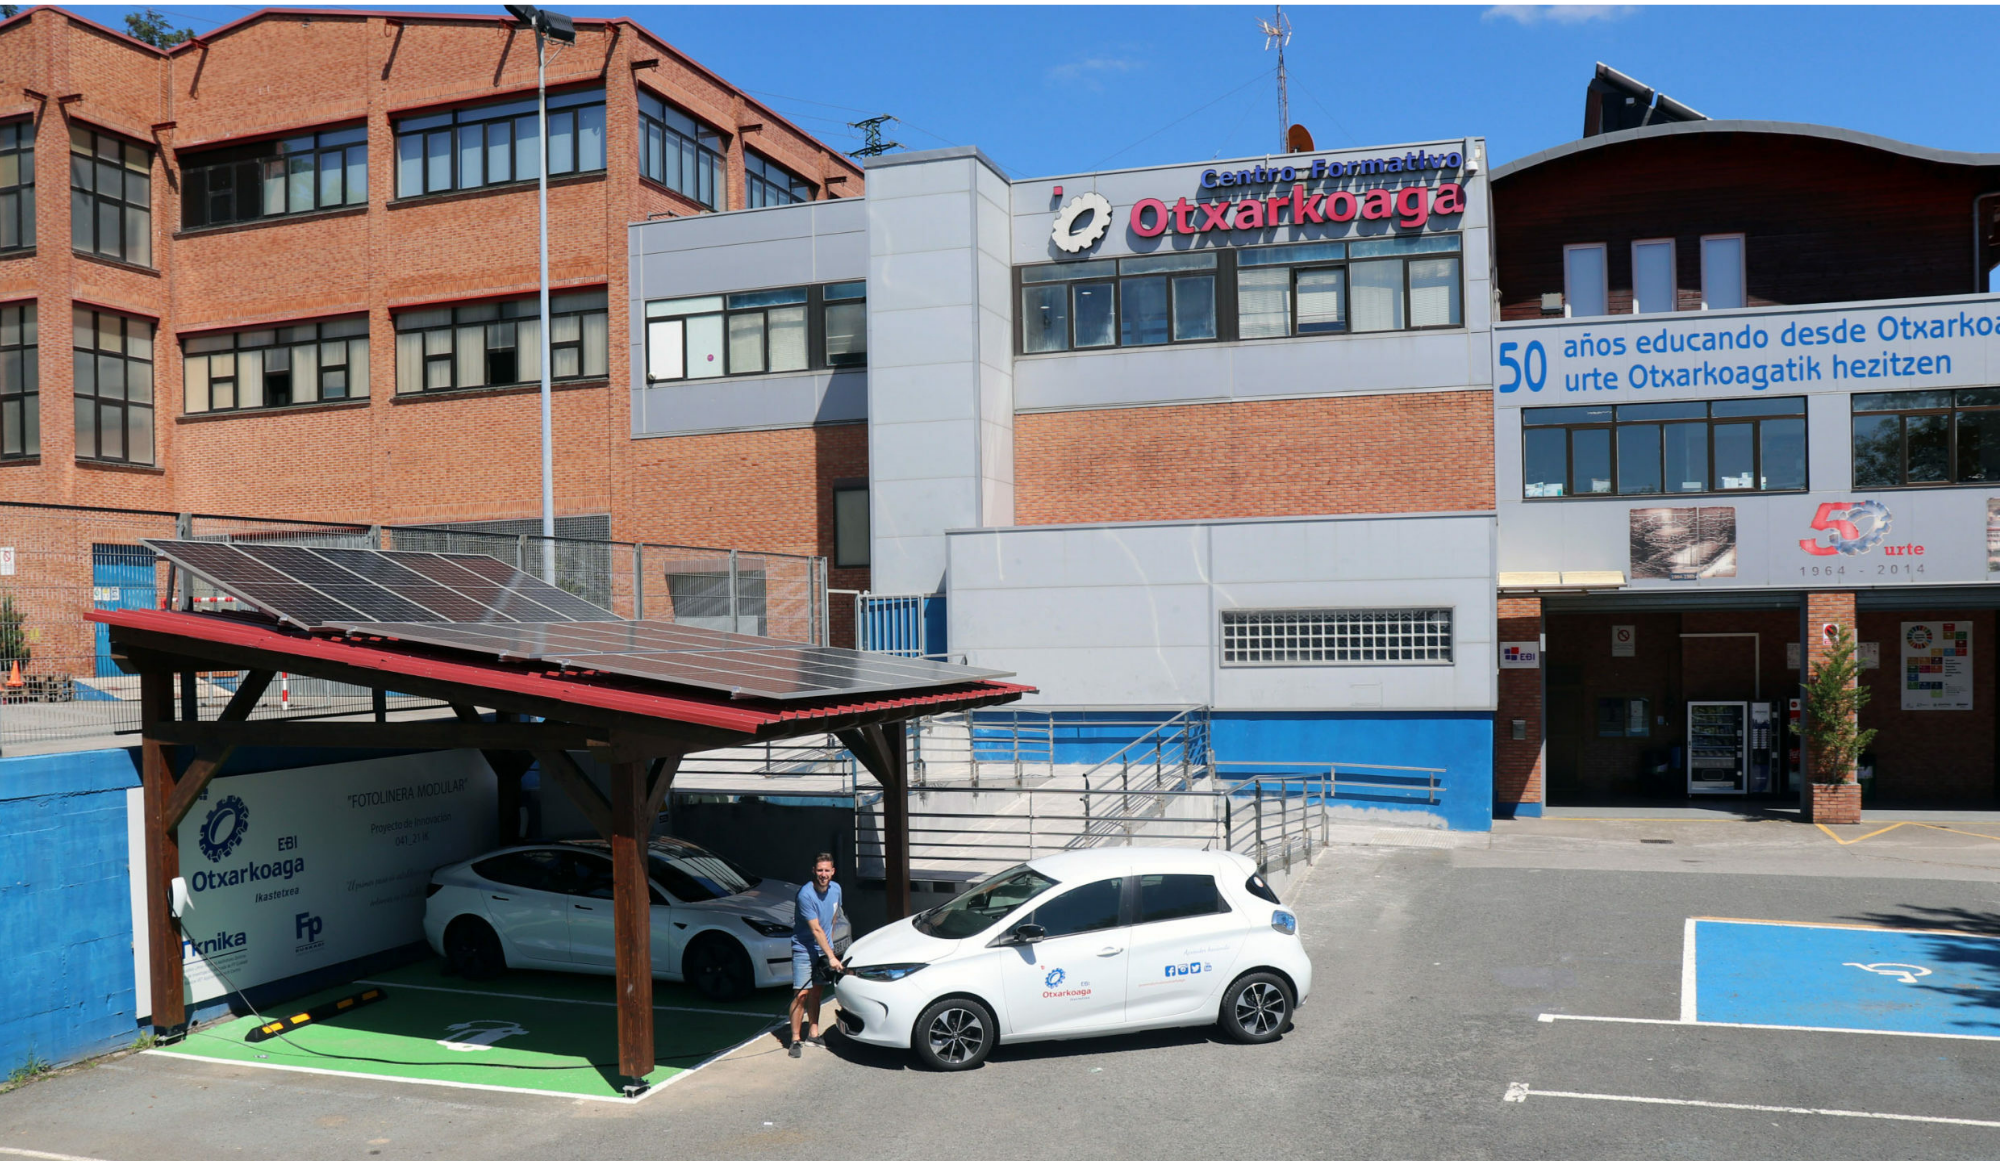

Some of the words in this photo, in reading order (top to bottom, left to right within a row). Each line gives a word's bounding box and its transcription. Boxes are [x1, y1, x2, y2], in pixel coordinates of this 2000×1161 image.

[1200, 164, 1296, 189] Centro
[1311, 150, 1463, 179] Formativo
[1130, 183, 1465, 238] Otxarkoaga
[1564, 332, 1626, 358] años
[1636, 325, 1769, 354] educando
[1780, 318, 1866, 347] desde
[1499, 340, 1547, 393] 50
[1565, 367, 1618, 391] urte
[1629, 356, 1821, 390] Otxarkoagatik
[1832, 351, 1951, 380] hezitzen
[1884, 543, 1925, 556] urte
[1800, 566, 1845, 577] 1964
[1878, 564, 1925, 575] 2014
[1520, 653, 1536, 661] EBI
[370, 822, 402, 835] Proyecto
[404, 818, 413, 829] de
[278, 835, 298, 852] EBI
[192, 857, 305, 893] Otxarkoaga
[255, 887, 300, 903] Ikastetxea
[295, 912, 323, 943] Fp
[1042, 988, 1092, 999] Otxarkoaga
